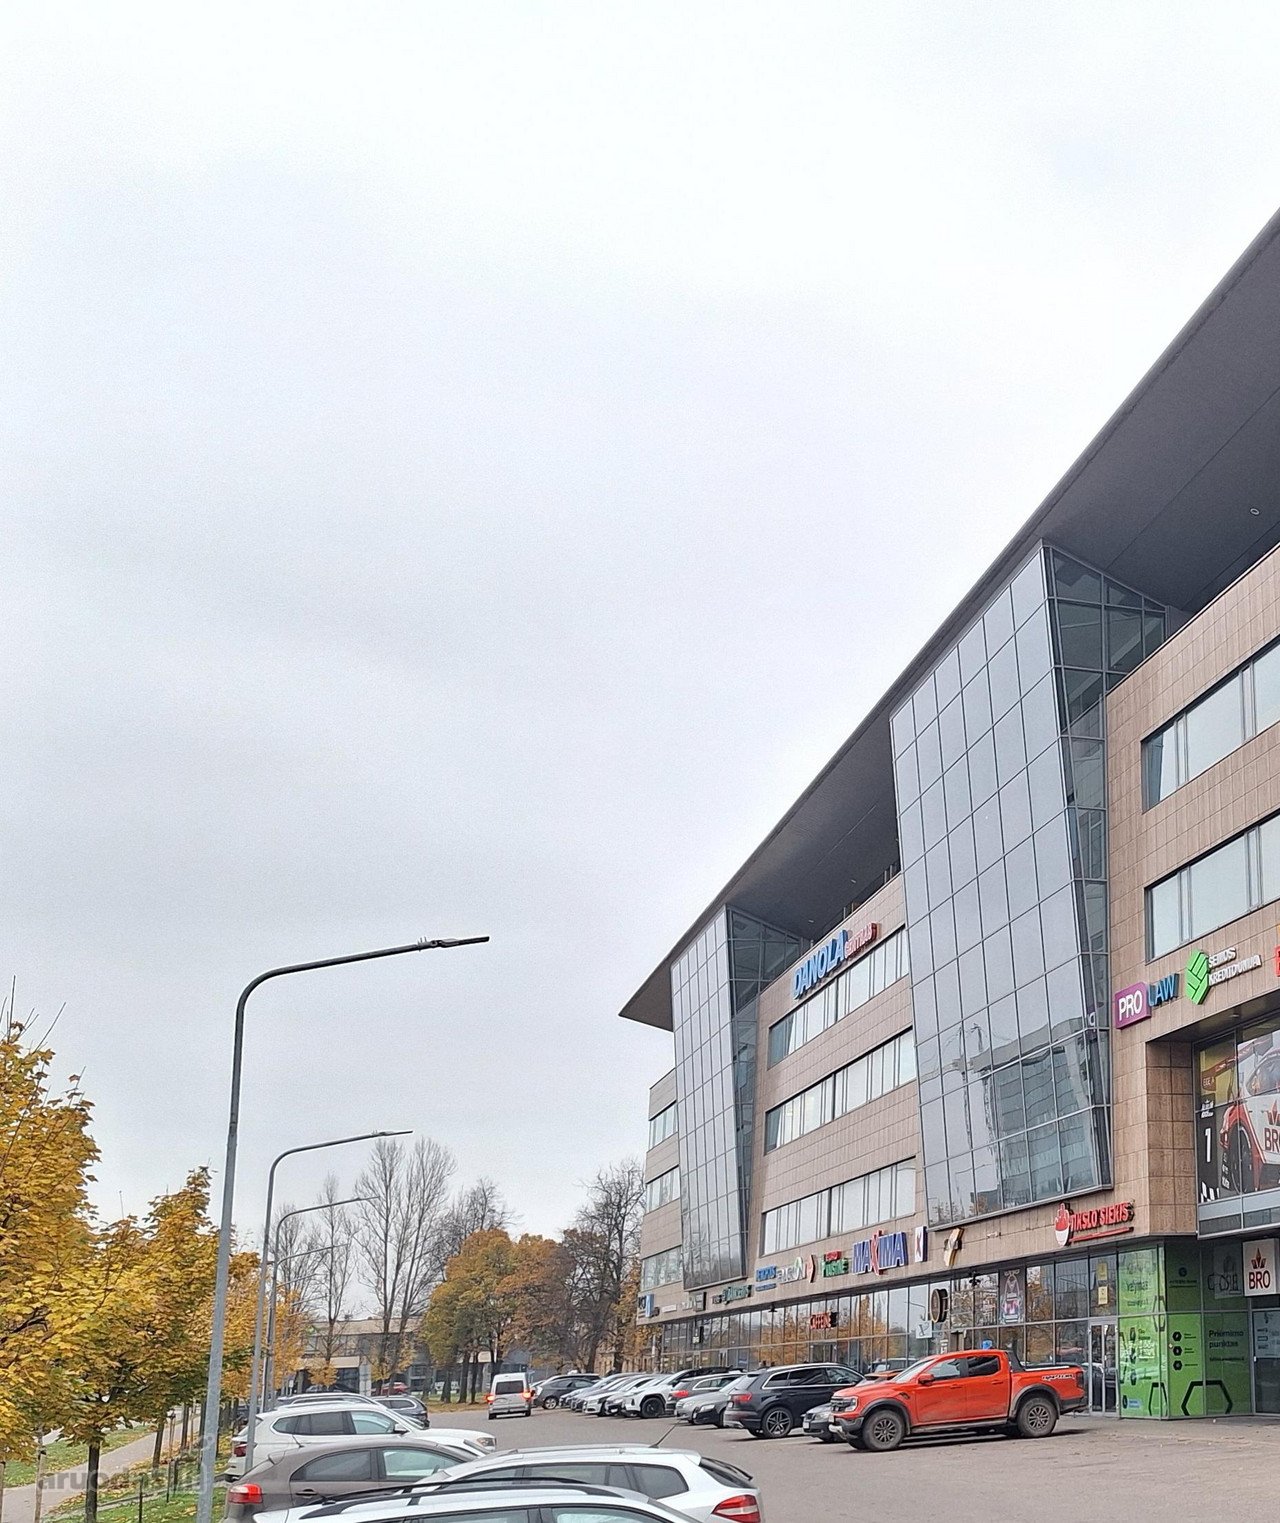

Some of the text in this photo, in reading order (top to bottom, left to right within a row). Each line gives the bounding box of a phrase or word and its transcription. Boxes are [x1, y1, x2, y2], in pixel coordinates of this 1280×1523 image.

[793, 929, 849, 1000] DANOLA
[1119, 973, 1179, 1021] PRO LAW
[1100, 1201, 1129, 1226] SIEKIS
[852, 1230, 907, 1276] MAXIMA
[1249, 1270, 1271, 1290] BRO
